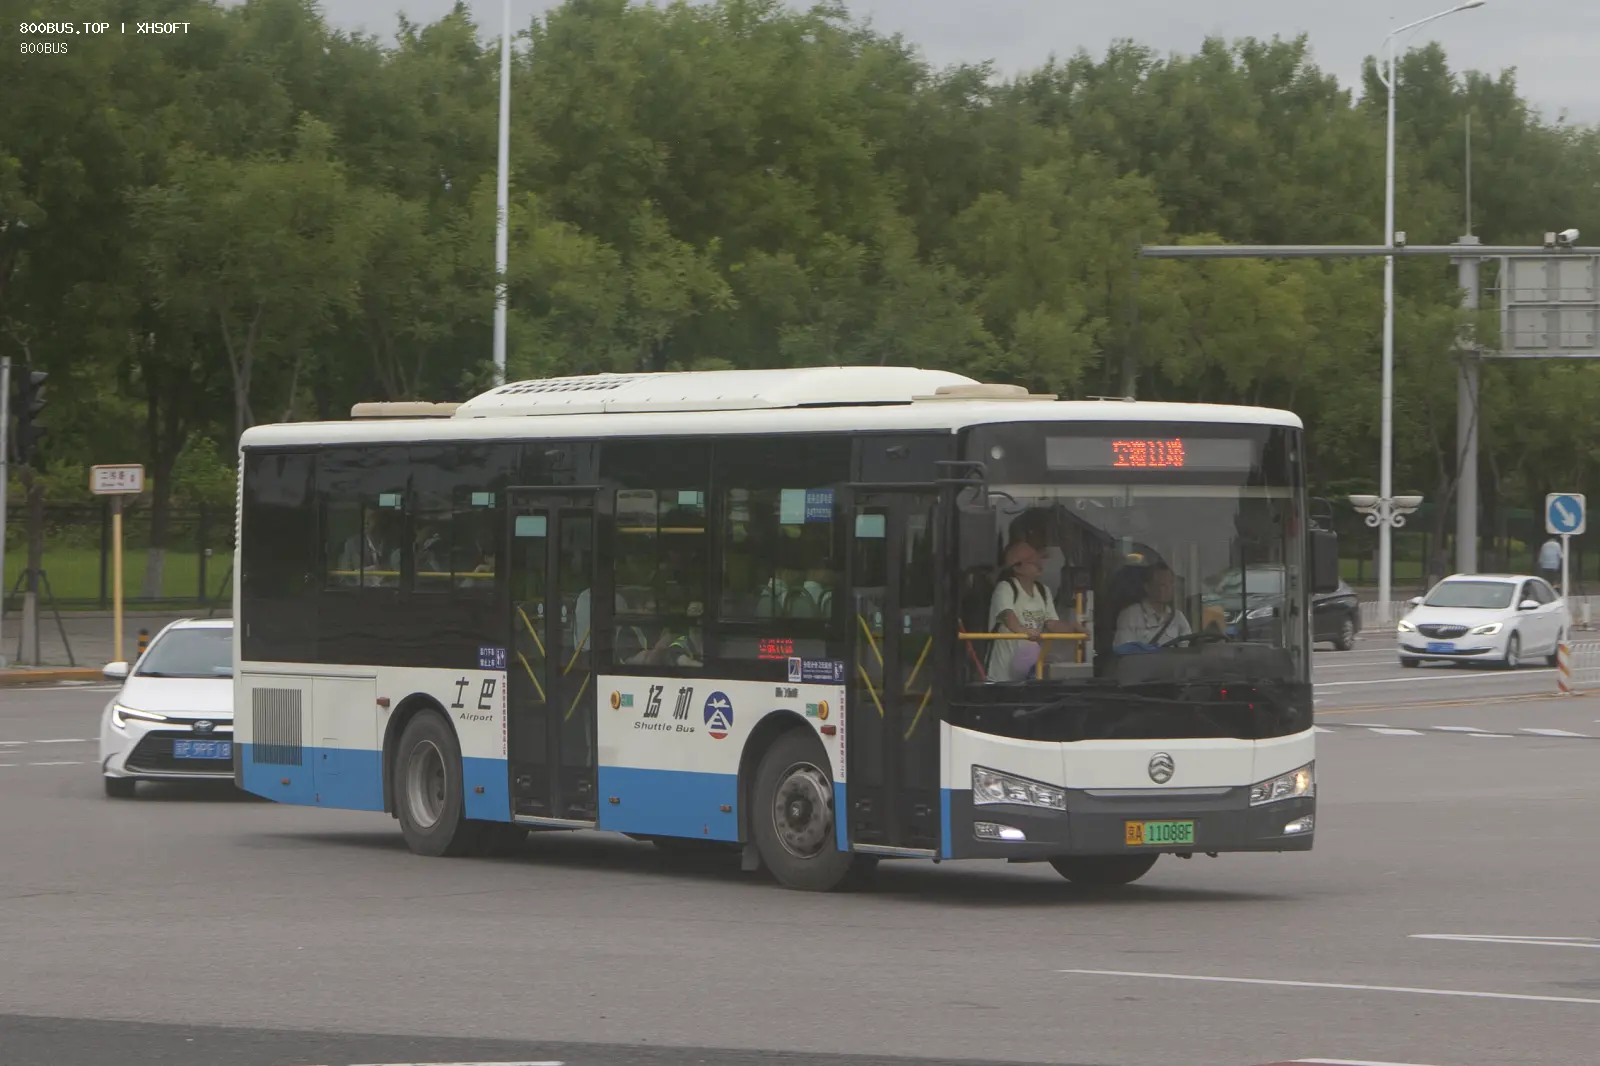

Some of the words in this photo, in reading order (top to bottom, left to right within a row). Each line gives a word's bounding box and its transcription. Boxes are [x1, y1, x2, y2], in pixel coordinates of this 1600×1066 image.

[460, 713, 493, 722] Airport
[633, 721, 672, 732] Shuttle
[675, 724, 695, 733] Bus
